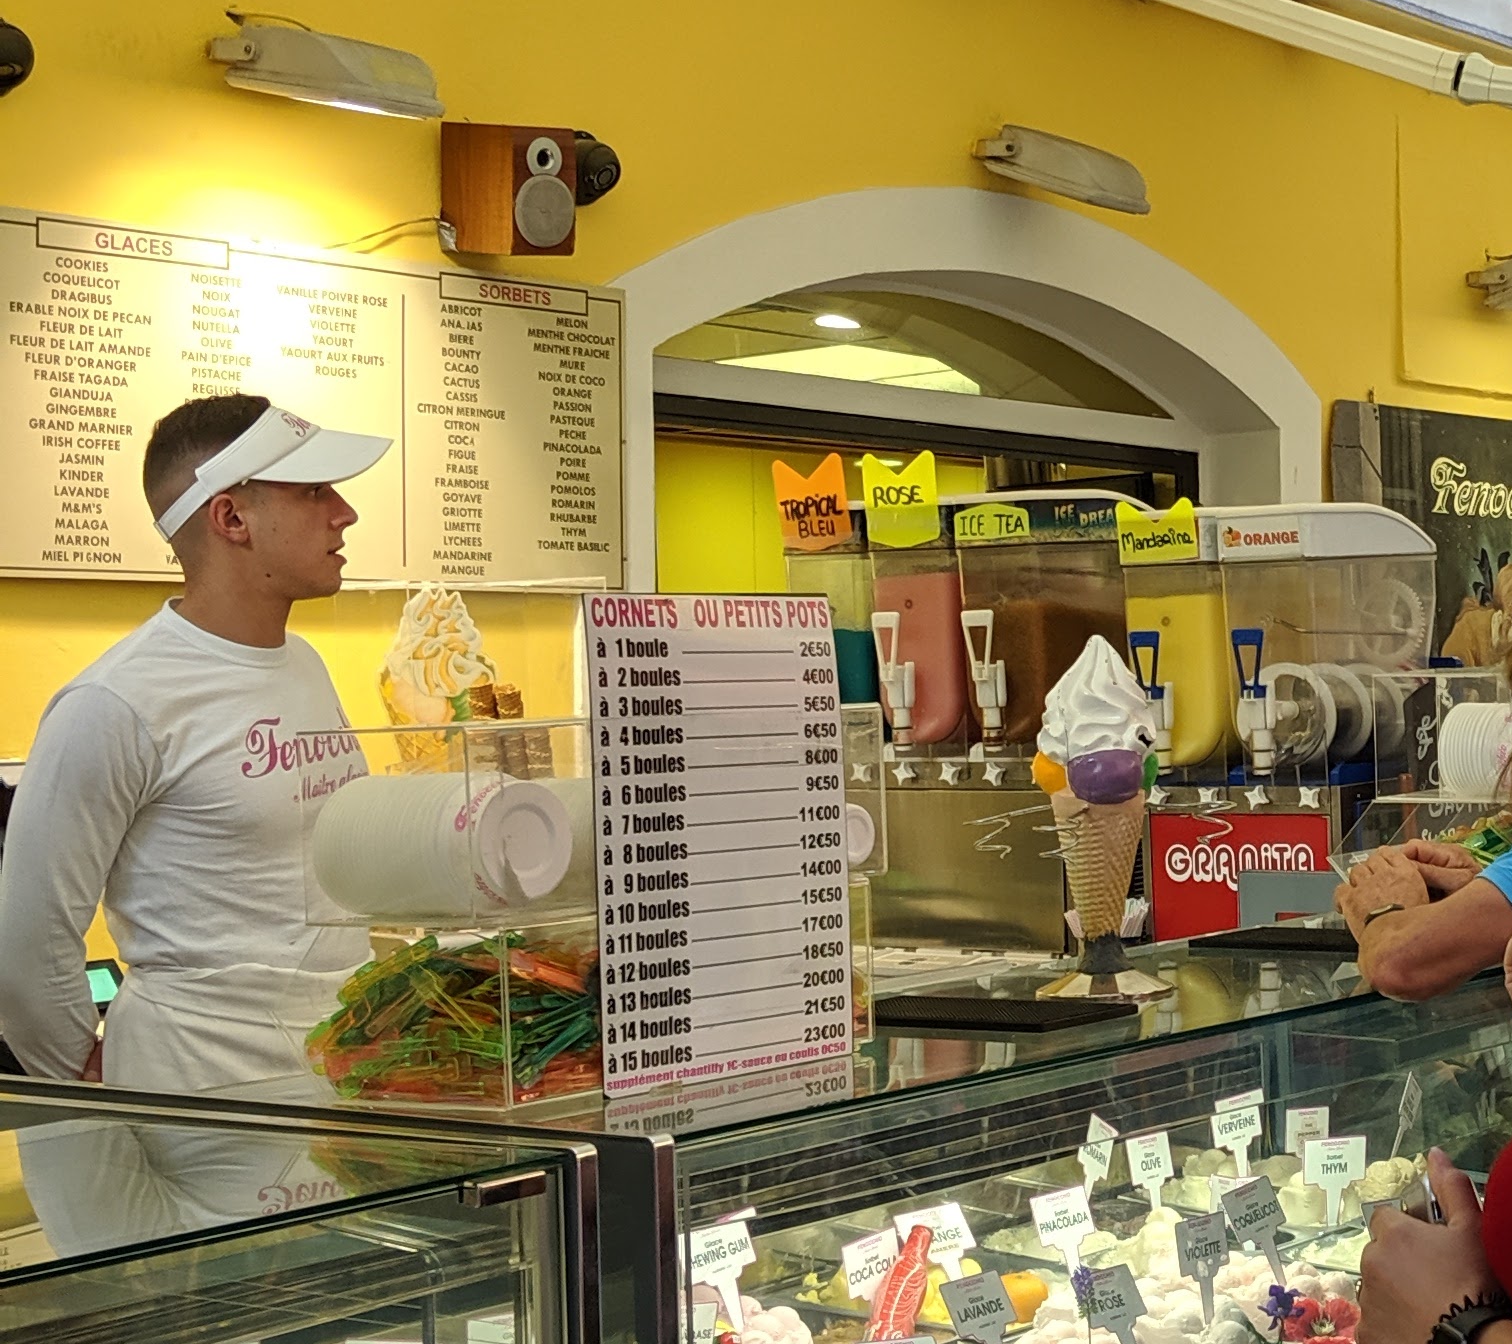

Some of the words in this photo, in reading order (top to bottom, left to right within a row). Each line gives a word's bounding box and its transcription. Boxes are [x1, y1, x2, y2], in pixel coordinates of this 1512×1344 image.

[95, 232, 173, 256] GLACES
[56, 257, 108, 272] COOKIES
[43, 272, 120, 290] COQUELICOT
[52, 289, 112, 305] DRAGIBUS
[479, 283, 551, 306] SORBETS
[10, 301, 53, 316] ERABLE
[58, 307, 89, 319] NOIX
[94, 310, 108, 321] DE
[112, 312, 151, 325] PECAN
[309, 304, 357, 318] VERVEINE
[441, 304, 482, 317] ABRICOT
[40, 321, 75, 334] FLEUR
[80, 325, 94, 336] DE
[99, 327, 123, 338] LAIT
[34, 369, 74, 382] FRAISE
[79, 373, 128, 387] TAGADA
[192, 367, 241, 381] PISTACHE
[316, 366, 357, 378] ROUGES
[443, 376, 480, 389] CACTUS
[446, 391, 478, 403] CASSIS
[553, 387, 592, 399] ORANGE
[553, 401, 592, 412] PASSION
[42, 435, 72, 448] IRISH
[77, 438, 120, 451] COFFEE
[60, 469, 103, 482] KINDER
[435, 477, 489, 490] FRAMBOISE
[54, 485, 109, 498] LAVANDE
[873, 486, 923, 507] ROSE
[443, 507, 483, 518] GRIOTTE
[1080, 507, 1116, 527] DREA
[55, 518, 109, 531] MALAGA
[799, 520, 835, 538] BLEU
[960, 515, 984, 536] ICE
[994, 514, 1024, 534] TEA
[55, 535, 109, 547] MARRON
[538, 540, 574, 551] TOMATE
[1243, 531, 1299, 547] ORANGE
[441, 565, 485, 576] MANGUE
[591, 597, 678, 629] CORNETS
[694, 598, 719, 628] OU
[723, 599, 783, 629] PETITS
[786, 600, 828, 628] POTS
[597, 637, 606, 658] à
[615, 639, 623, 657] 1
[626, 638, 669, 658] boule
[800, 641, 831, 657] 2€50
[598, 667, 608, 687] à
[617, 667, 627, 687] 2
[630, 667, 681, 686] boules
[803, 669, 834, 684] 4€00
[600, 697, 609, 717] à
[619, 697, 629, 717] 3
[632, 696, 683, 716] boules
[804, 696, 835, 712] 5€50
[600, 727, 610, 747] à
[619, 726, 629, 746] 4
[632, 725, 684, 745] boules
[804, 723, 837, 738] 6€50
[601, 756, 611, 776] à
[621, 756, 630, 775] 5
[634, 754, 685, 774] boules
[805, 748, 838, 764] 8€00
[602, 786, 611, 806] à
[621, 785, 631, 805] 6
[635, 783, 686, 804] boules
[806, 775, 839, 791] 9€50
[604, 875, 613, 896] à
[624, 874, 633, 894] 9
[637, 870, 689, 891] boules
[800, 859, 841, 877] 14€00
[606, 964, 616, 985] à
[618, 962, 635, 983] 12
[639, 958, 690, 981] boules
[802, 941, 844, 960] 18€50
[608, 1053, 617, 1074] à
[621, 1050, 637, 1072] 15
[642, 1045, 692, 1068] boules
[804, 1023, 845, 1042] 23€00
[1218, 1115, 1255, 1135] VERVEINE
[1141, 1157, 1161, 1171] OLIVE
[1321, 1162, 1348, 1174] THYM
[1039, 1211, 1089, 1234] PINACOLADA
[1234, 1201, 1279, 1230] COQUELICOT
[931, 1227, 962, 1243] ANGE
[691, 1246, 727, 1270] HEWING
[728, 1237, 750, 1255] GUM
[1185, 1240, 1221, 1261] VIOLETTE
[849, 1266, 873, 1286] COCA
[957, 1298, 1004, 1323] LAVANDE
[1098, 1294, 1126, 1314] ROSE
